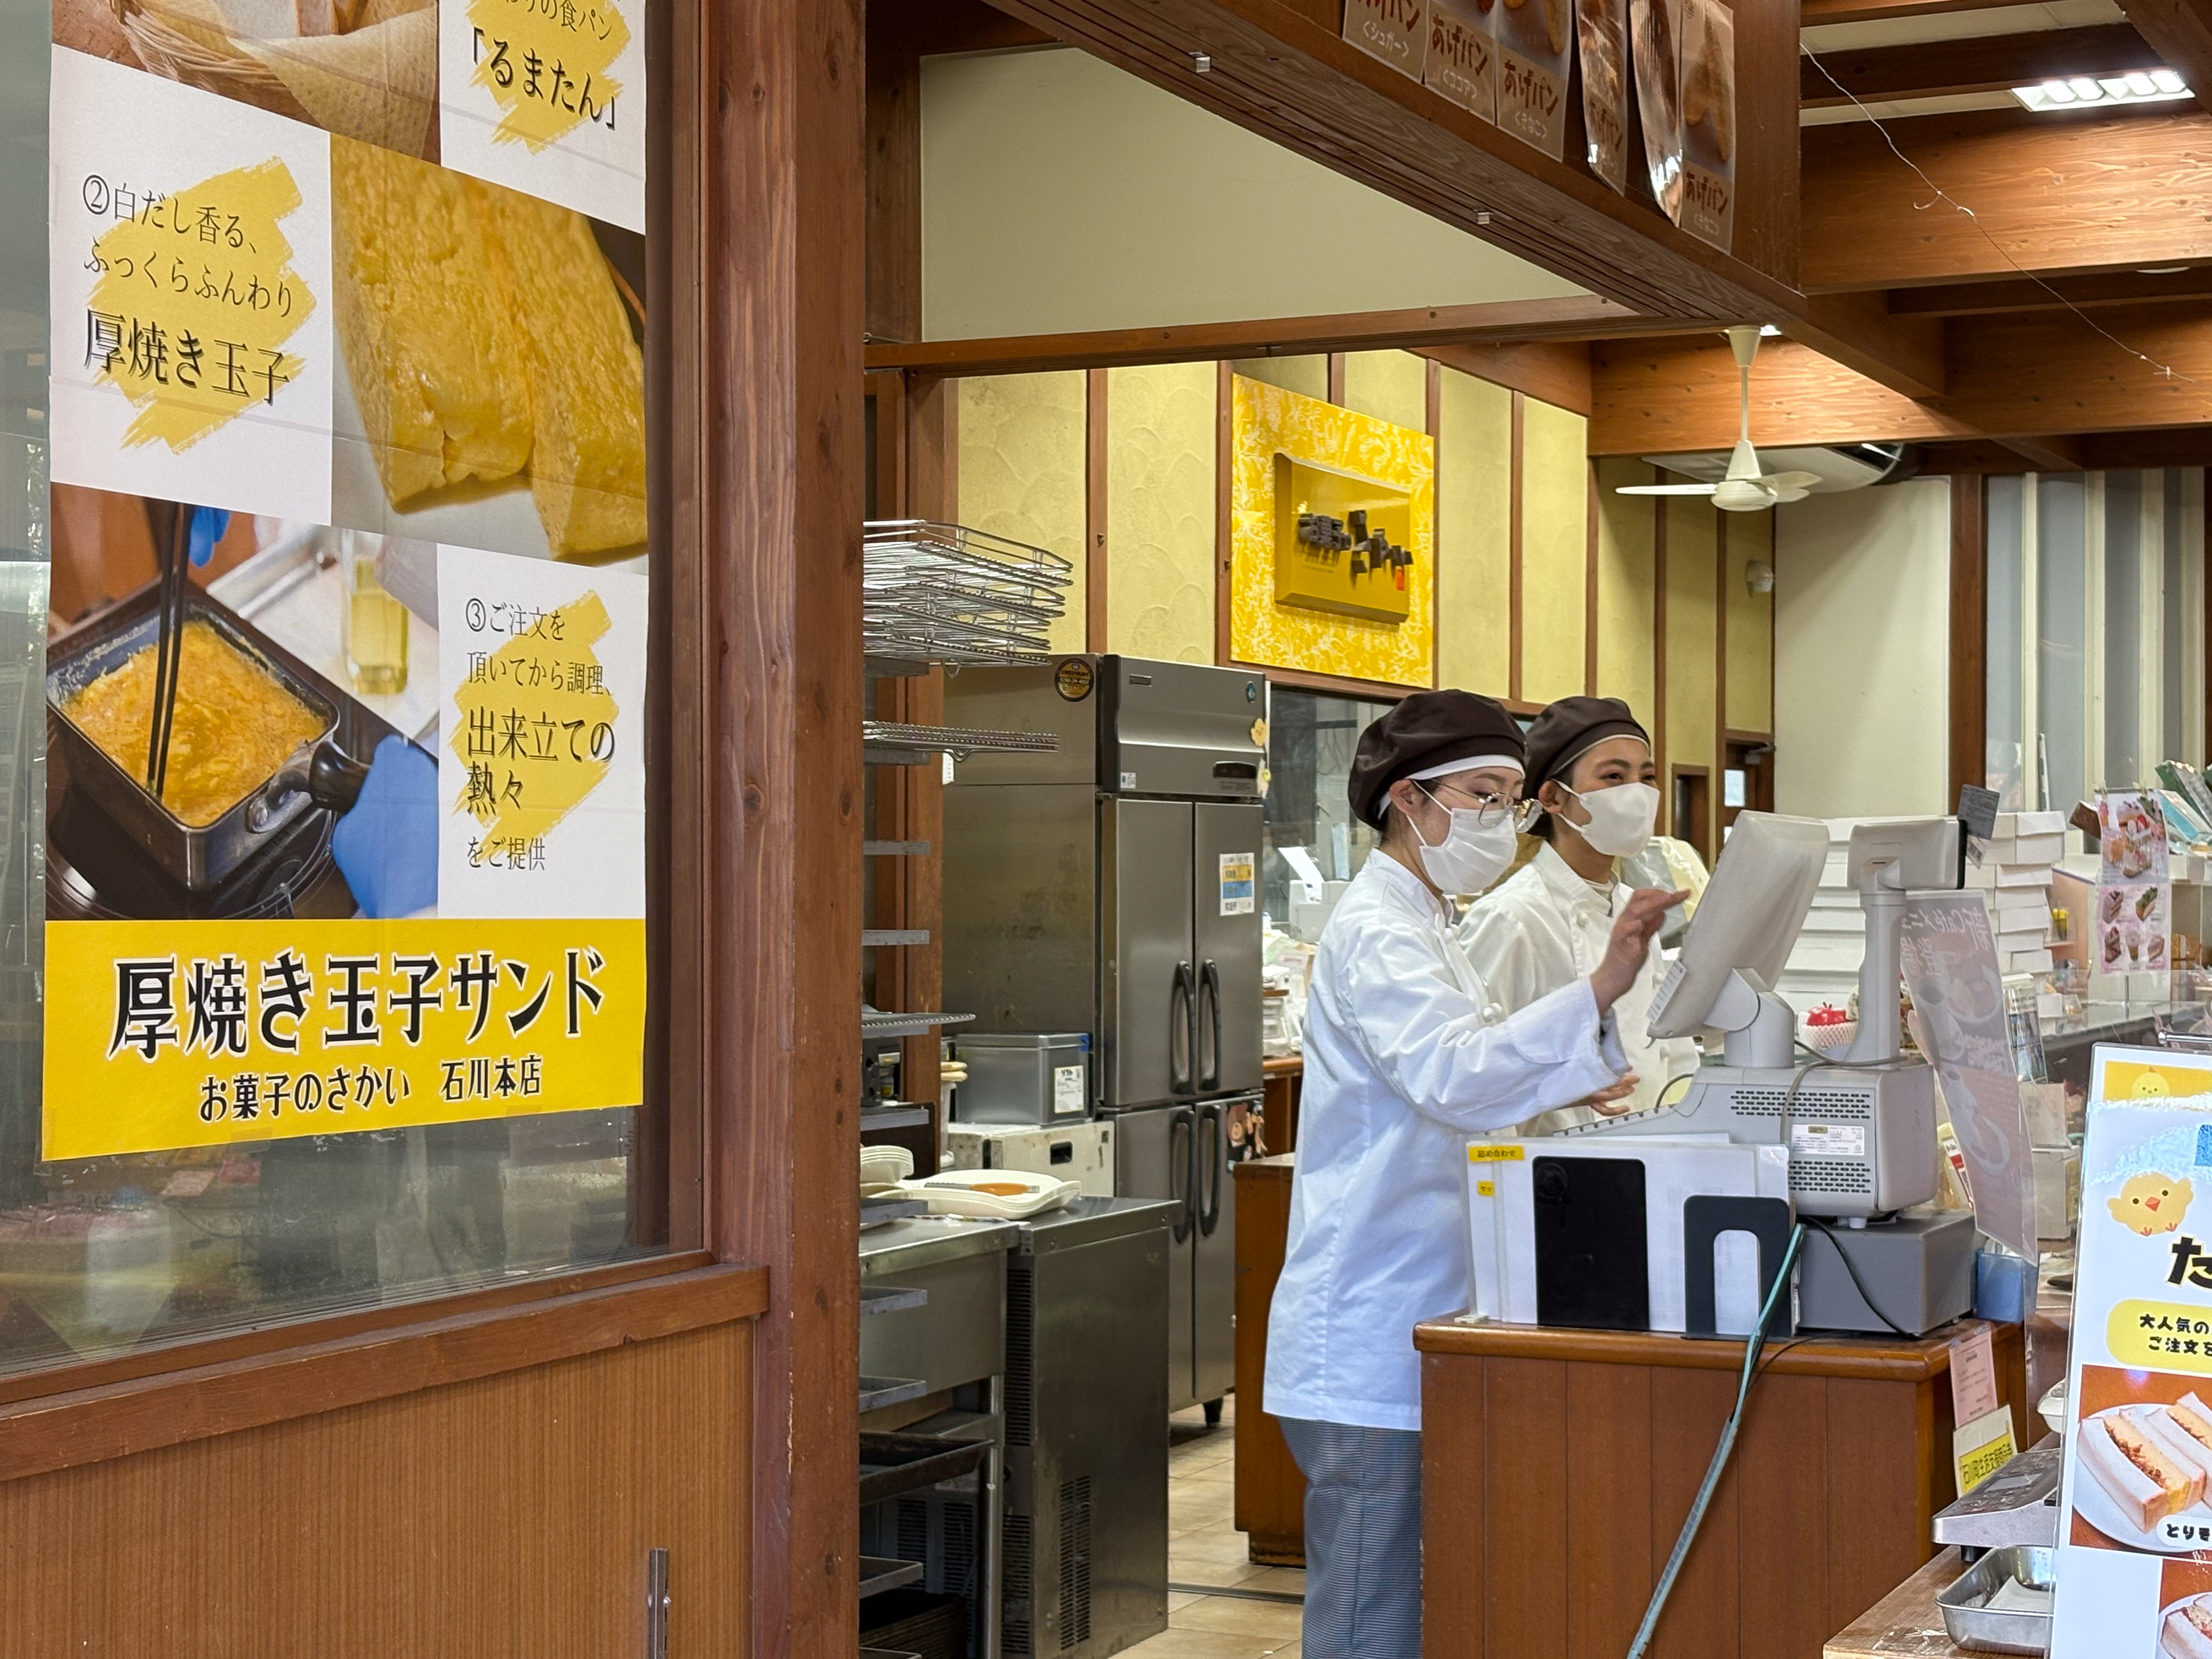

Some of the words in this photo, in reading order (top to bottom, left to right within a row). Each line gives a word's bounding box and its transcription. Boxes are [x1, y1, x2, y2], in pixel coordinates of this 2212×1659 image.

[1432, 14, 1488, 76] あげパン
[473, 26, 615, 132] 「るまたん」
[1504, 59, 1559, 117] あげパン
[1686, 169, 1728, 216] あげパン
[83, 236, 291, 318] ふっくらふんわり
[84, 308, 290, 406] 厚焼き玉子
[466, 598, 565, 641] ③ご注文を
[466, 651, 614, 696] 頂いてから調理、
[468, 706, 615, 763] 出来立ての
[467, 760, 523, 816] 熱々
[467, 836, 546, 871] をご提供
[109, 947, 605, 1059] 厚焼き玉子サンド
[200, 1063, 411, 1122] お菓子のさかい
[440, 1053, 542, 1101] 石川本店
